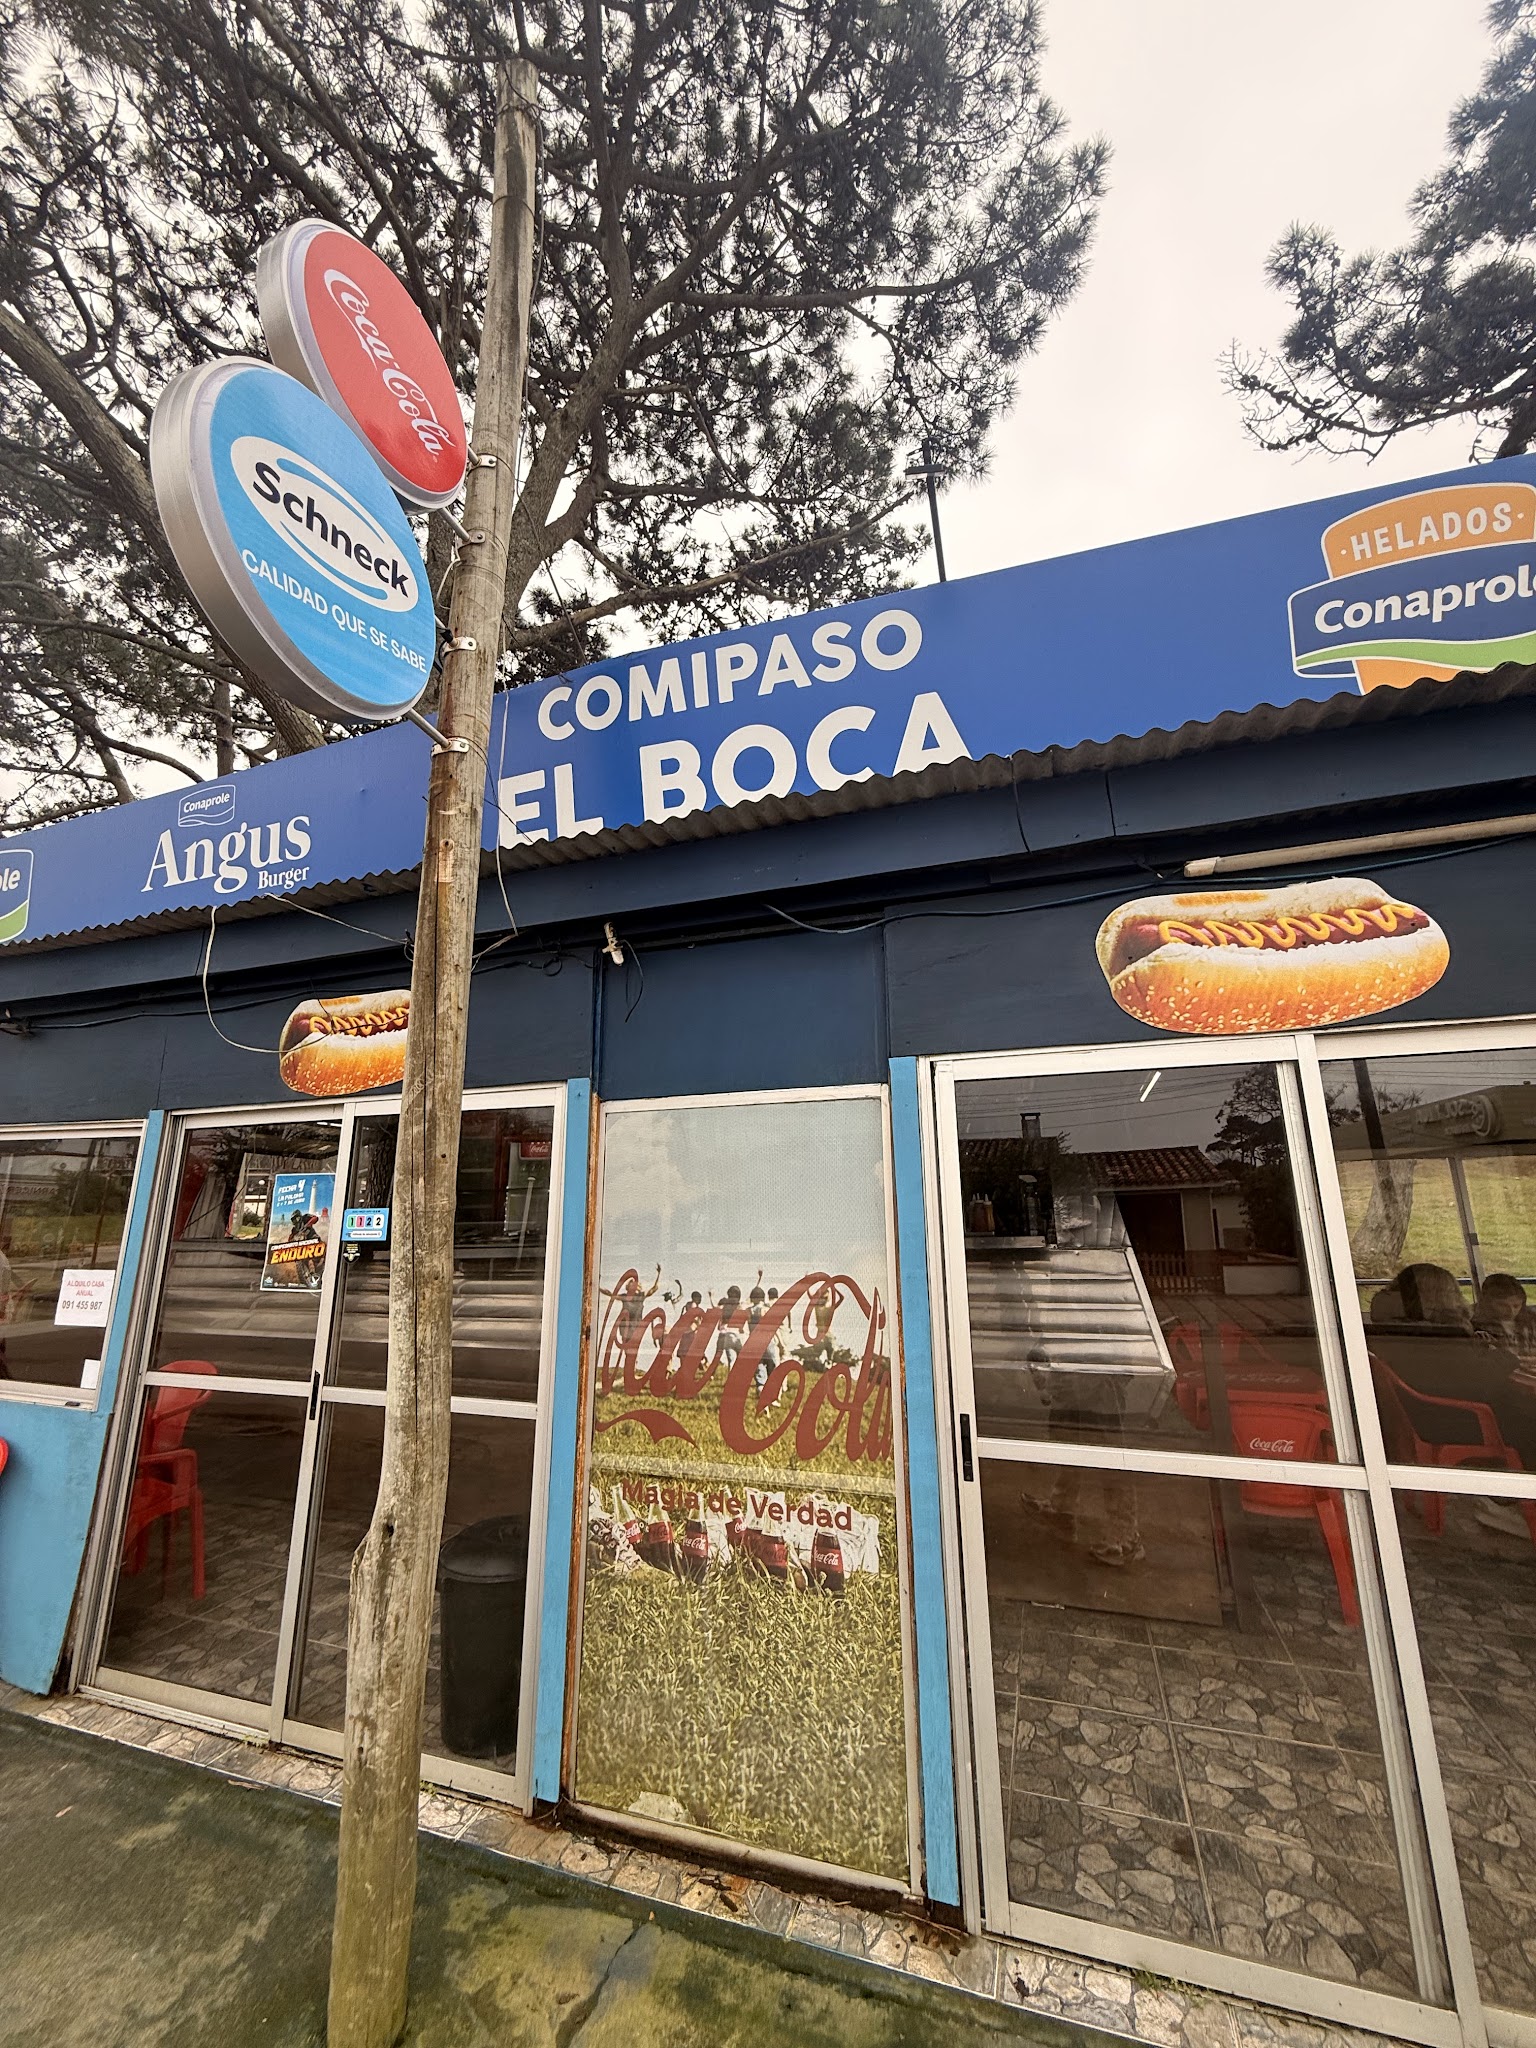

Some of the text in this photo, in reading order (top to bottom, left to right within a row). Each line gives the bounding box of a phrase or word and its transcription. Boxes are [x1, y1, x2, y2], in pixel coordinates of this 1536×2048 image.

[324, 269, 456, 457] Coca-Cola
[253, 461, 409, 598] Schneck
[1350, 502, 1512, 561] HELADOS
[242, 549, 427, 674] CALIDAD QUE SE SABE
[1314, 564, 1536, 634] Conaprol
[537, 609, 923, 741] COMIPASO
[498, 691, 972, 849] EL BOCA
[183, 792, 230, 813] Conaprole
[141, 816, 312, 894] Angus
[257, 866, 310, 890] Burger
[67, 1280, 105, 1288] ALQUILO CASA
[270, 1242, 326, 1264] ENDURO
[62, 1300, 103, 1310] 091 455 987
[622, 1480, 700, 1512] Magia
[707, 1490, 742, 1516] de
[750, 1494, 853, 1532] Verdad
